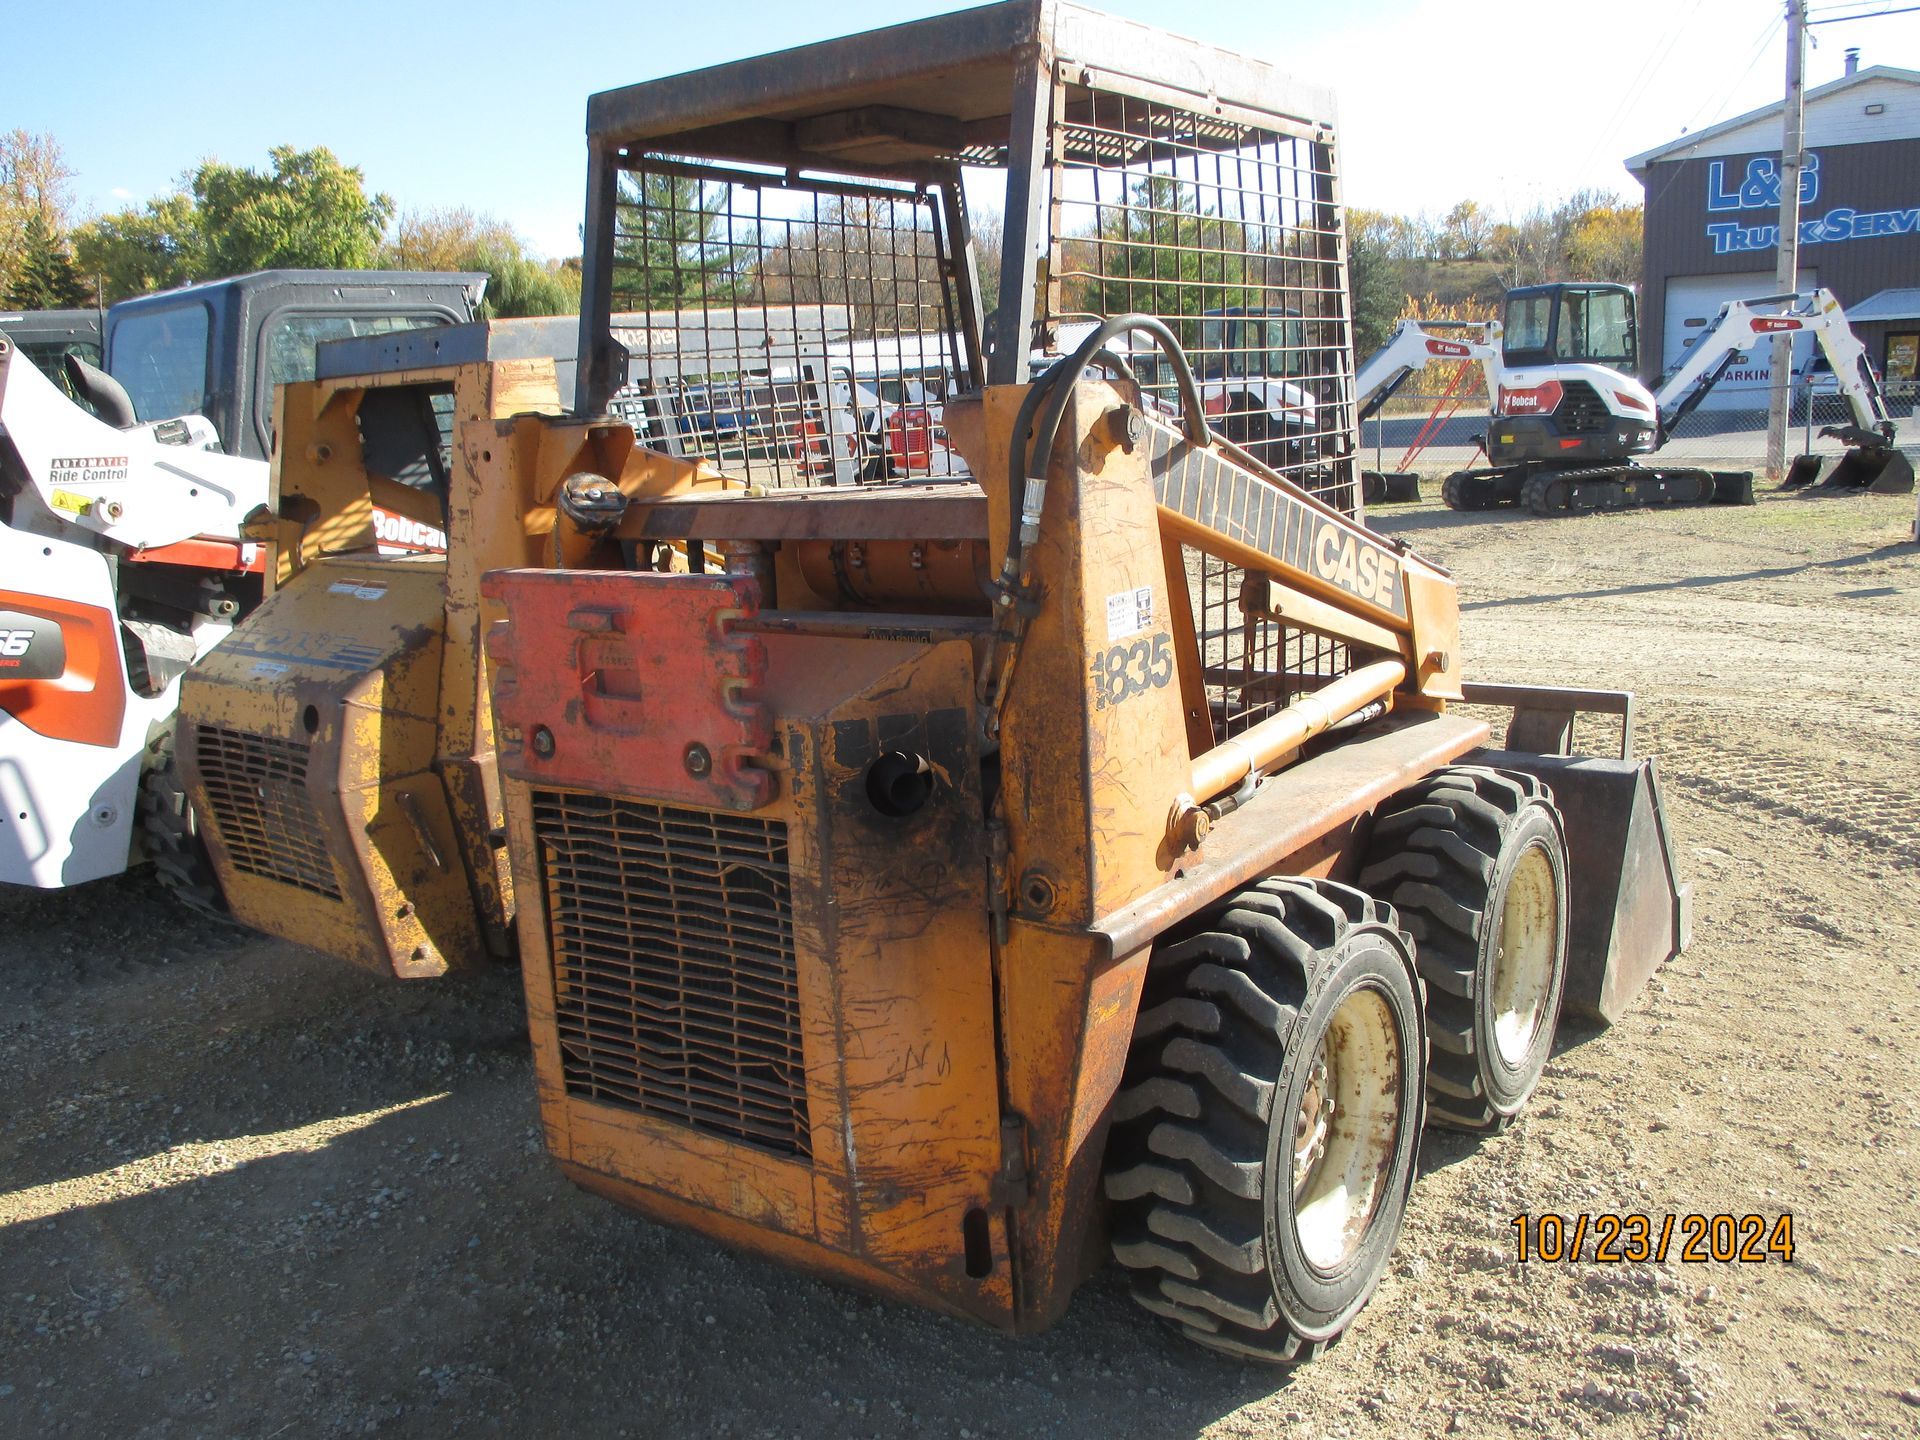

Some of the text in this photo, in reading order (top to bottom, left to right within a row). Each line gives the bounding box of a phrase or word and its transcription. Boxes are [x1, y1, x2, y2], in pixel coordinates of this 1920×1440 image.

[1721, 369, 1772, 381] ARKIN
[1511, 396, 1537, 407] Bobcat
[52, 457, 128, 469] AUTOMATIC
[50, 468, 128, 482] Ride Control
[1316, 523, 1396, 608] CASE
[1089, 631, 1173, 709] 1835
